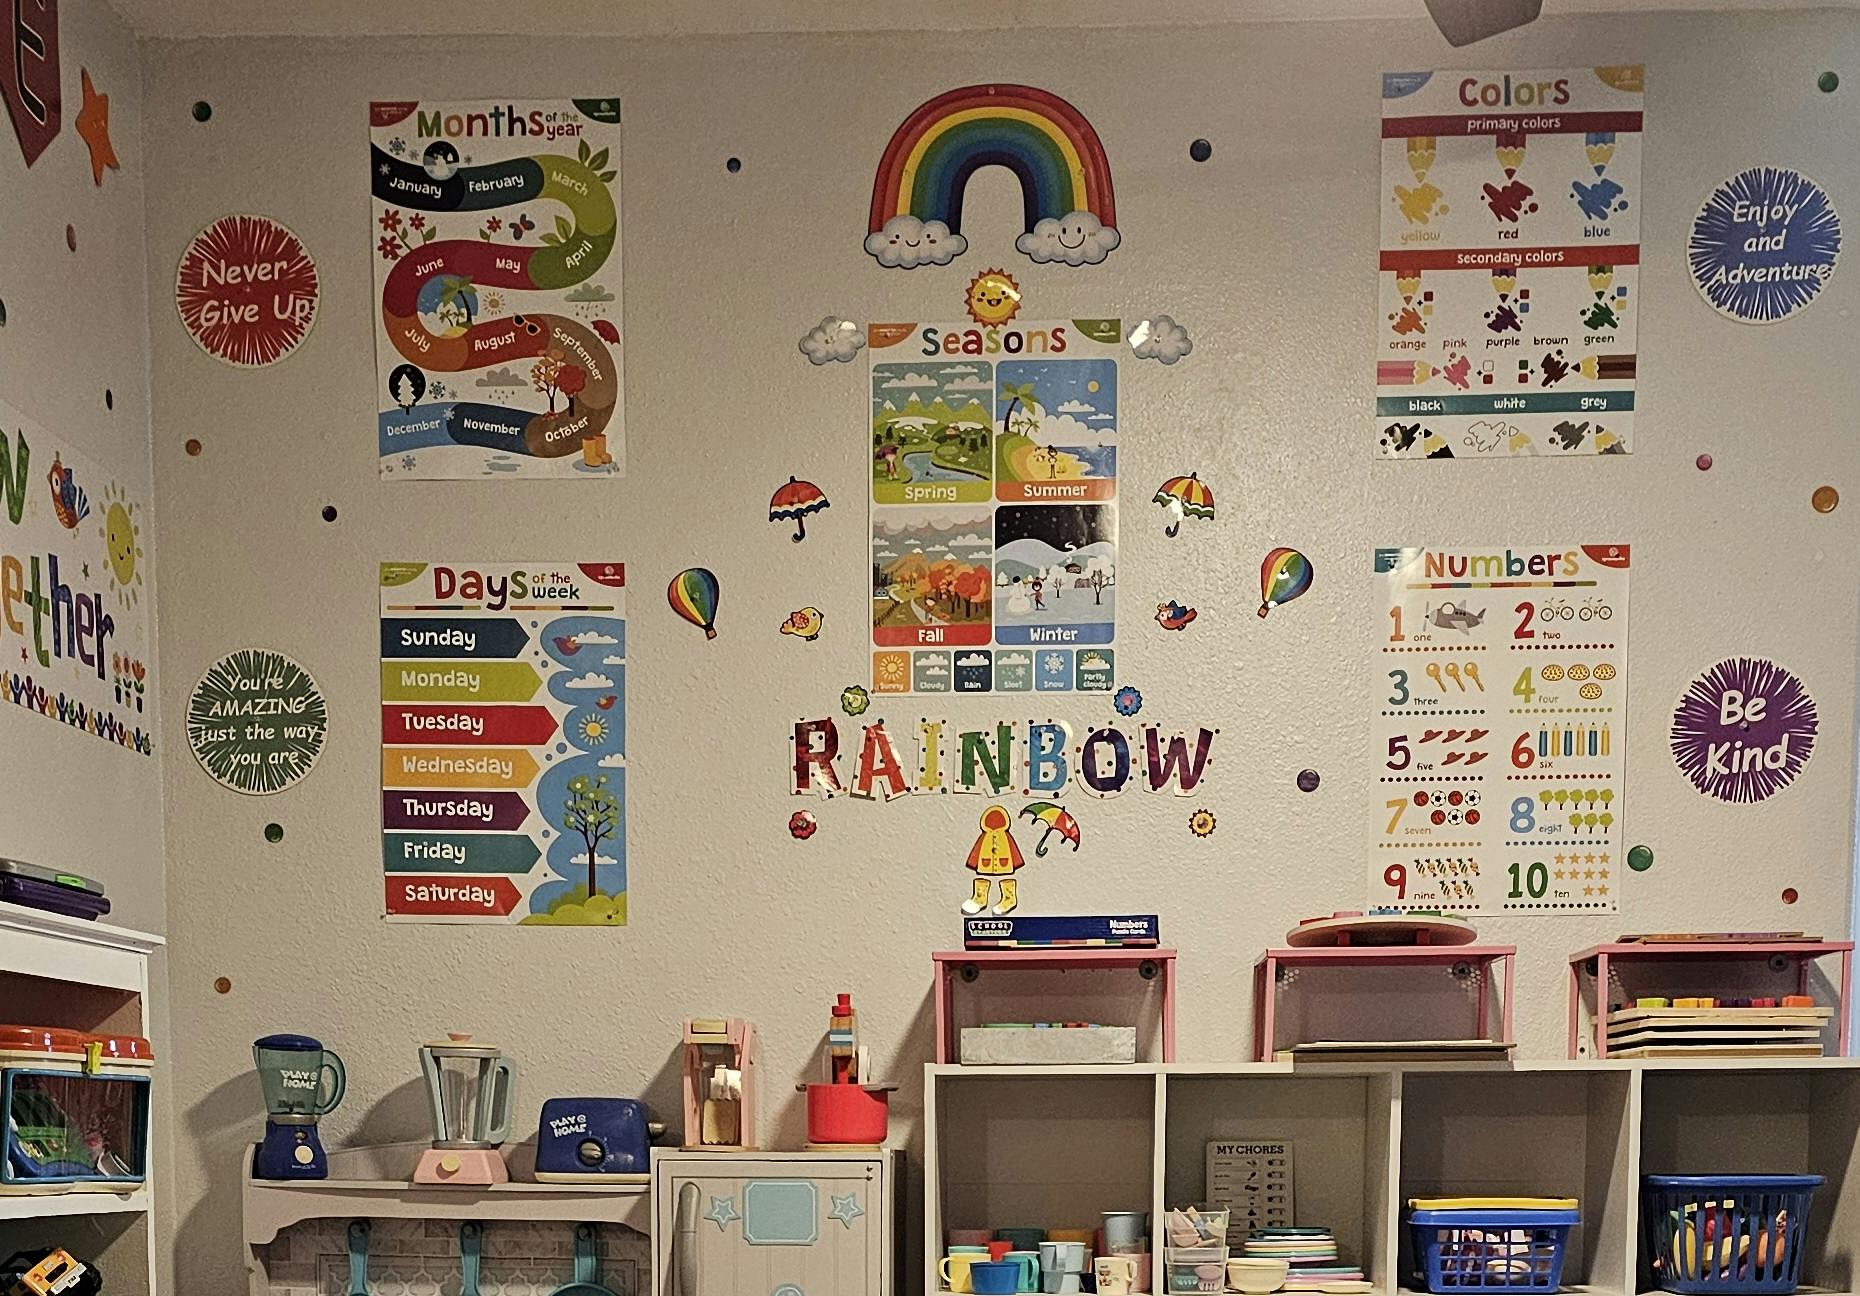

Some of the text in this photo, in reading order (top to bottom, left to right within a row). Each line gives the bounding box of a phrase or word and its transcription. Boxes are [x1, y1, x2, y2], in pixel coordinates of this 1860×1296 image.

[1459, 75, 1570, 107] Colors
[417, 104, 545, 138] Months
[545, 111, 578, 122] of the
[1467, 115, 1561, 132] primary colors
[546, 122, 583, 141] year
[389, 170, 589, 199] January February March
[1733, 200, 1798, 227] Enjoy
[1401, 226, 1610, 245] yellow red blue
[1744, 229, 1786, 252] and
[415, 240, 593, 277] June May April
[1457, 251, 1564, 265] secondary colors
[202, 259, 288, 288] Never
[1709, 262, 1832, 285] Adventure
[200, 293, 311, 327] Give Up
[922, 327, 1067, 356] Seasons
[1389, 335, 1615, 351] orange pink purple brown green
[404, 327, 603, 382] July August September
[1409, 400, 1441, 411] black
[1494, 398, 1526, 408] white
[386, 415, 590, 443] December November October
[905, 484, 1088, 501] Spring Summer
[1424, 550, 1580, 578] Numbers
[433, 567, 529, 611] Days
[532, 571, 571, 584] of the
[532, 584, 580, 599] week
[0, 553, 115, 681] ether
[1390, 606, 1432, 642] 1 one
[1513, 601, 1561, 640] 2 two
[401, 629, 476, 651] Sunday
[918, 628, 1078, 643] Fall Winter
[401, 670, 481, 692] Monday
[1388, 669, 1439, 706] 3 three
[1513, 666, 1559, 705] 4 four
[209, 697, 306, 717] AMAZING
[1720, 689, 1767, 726] Be
[199, 723, 319, 747] just the way
[401, 713, 484, 736] Tuesday
[230, 752, 299, 770] you are
[793, 718, 1216, 799] RAINBOW
[1385, 735, 1434, 771] 5 five
[1511, 731, 1554, 769] 6 six
[1706, 732, 1790, 778] Kind
[402, 755, 513, 779] Wednesday
[402, 799, 494, 822] Thursday
[1385, 798, 1432, 835] 7 seven
[1509, 796, 1562, 834] 8 eight
[404, 841, 466, 864] Friday
[1384, 863, 1436, 901] 9 nine
[1507, 862, 1570, 899] 10 ten
[405, 883, 495, 907] Saturday
[280, 1069, 310, 1080] PLAY
[283, 1079, 317, 1090] HOME
[549, 1115, 576, 1129] PLAY
[554, 1124, 587, 1138] HOME
[1217, 1145, 1284, 1155] MY CHORES
